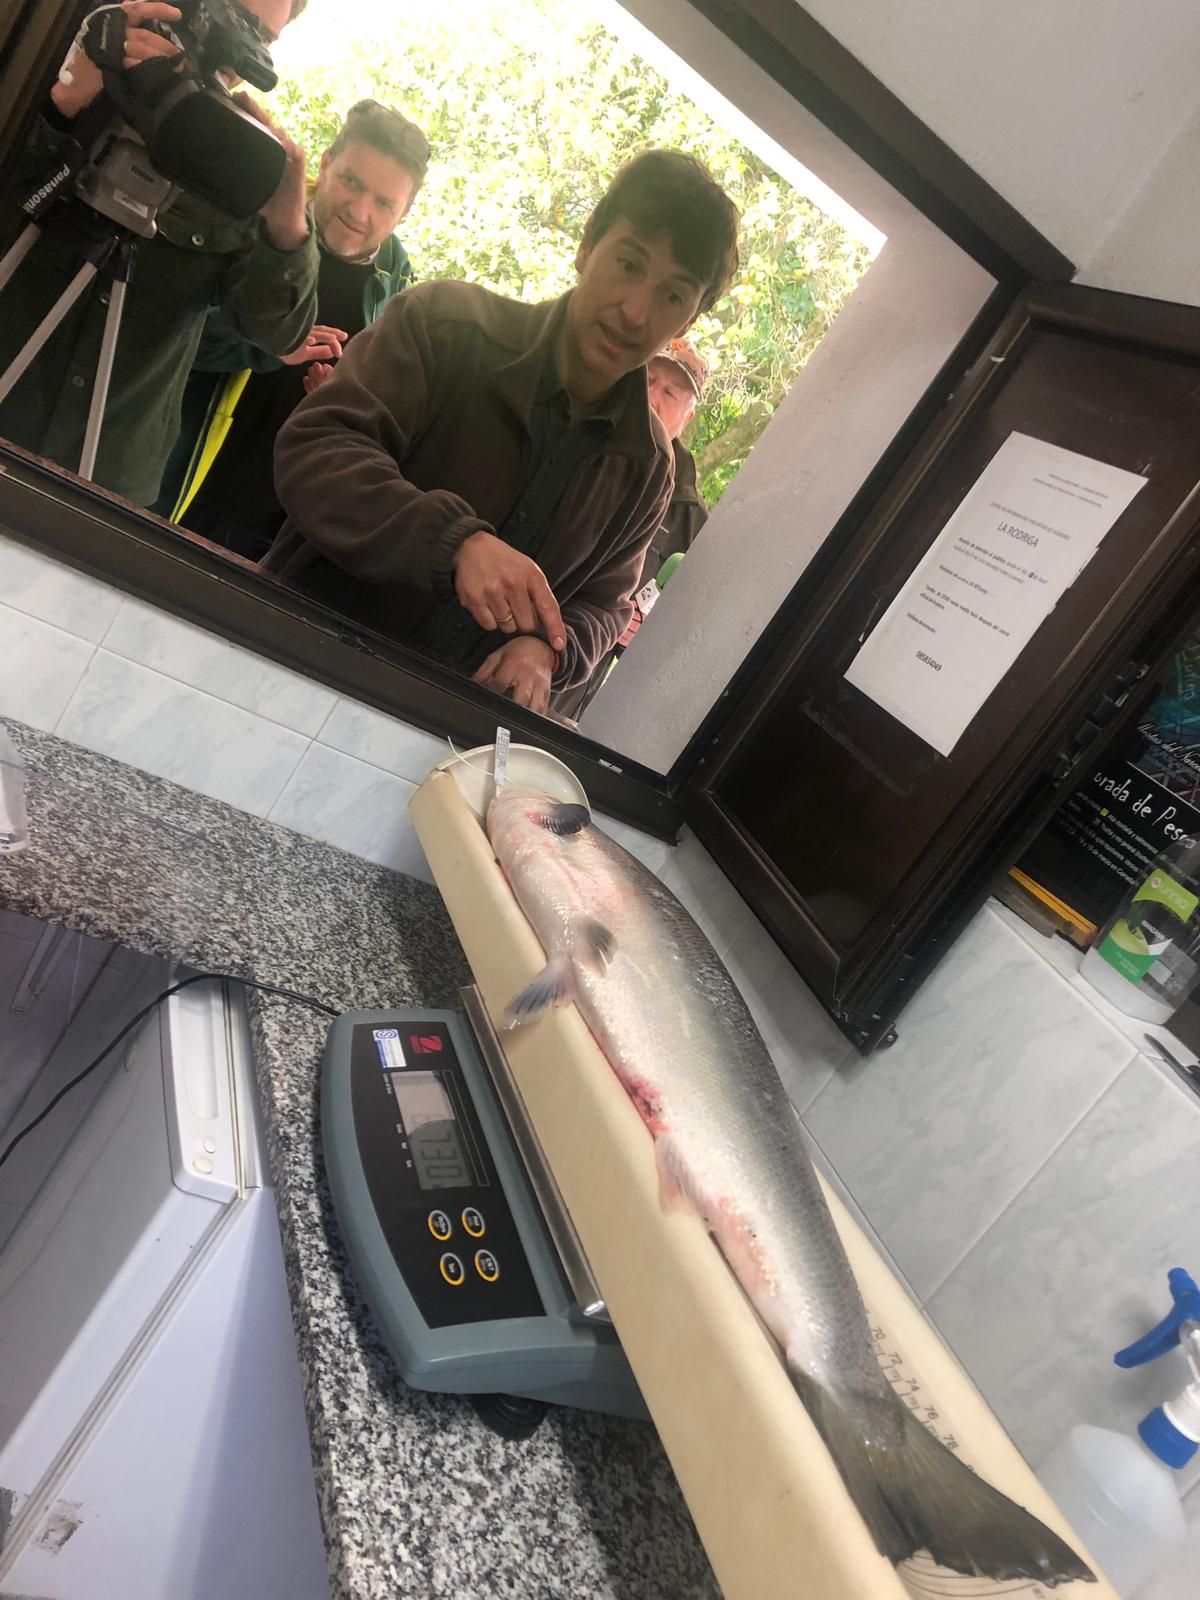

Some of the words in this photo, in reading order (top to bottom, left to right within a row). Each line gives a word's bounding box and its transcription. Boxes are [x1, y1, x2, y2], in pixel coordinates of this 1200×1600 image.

[997, 521, 1008, 533] LA
[1006, 525, 1039, 547] RODRIGA
[1093, 773, 1131, 802] orada
[1132, 793, 1152, 818] de
[413, 1115, 463, 1180] 730
